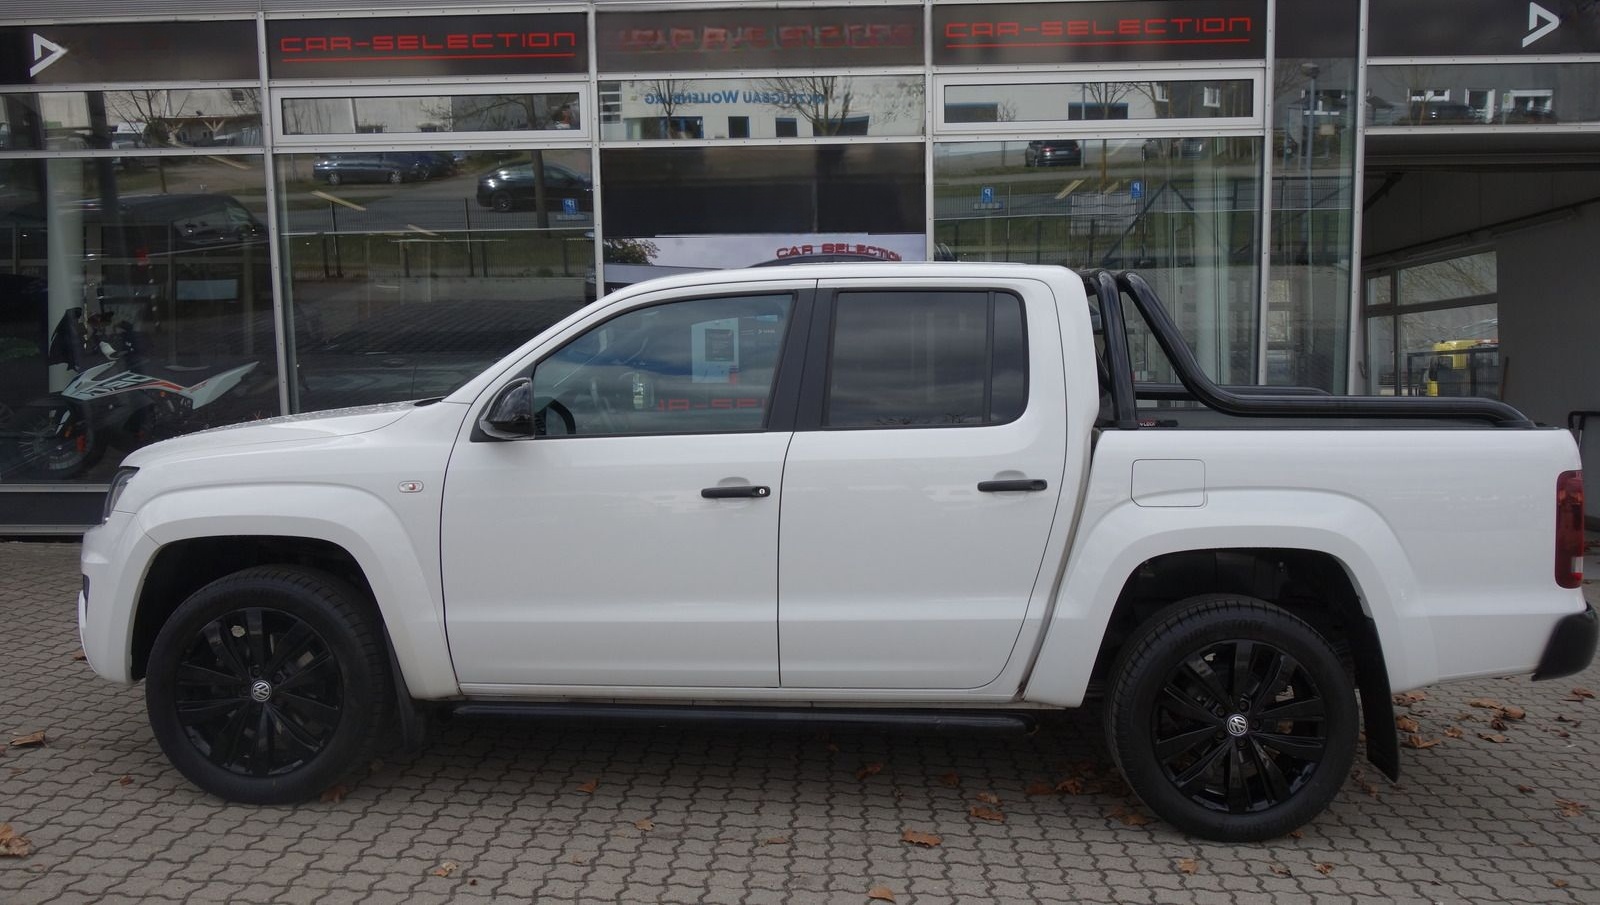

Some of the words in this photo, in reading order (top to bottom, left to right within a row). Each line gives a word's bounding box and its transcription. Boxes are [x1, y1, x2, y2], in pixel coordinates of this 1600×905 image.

[945, 17, 1251, 38] CAR-SELECTION
[281, 32, 576, 53] CAR-SELECTION
[776, 244, 813, 259] CAR
